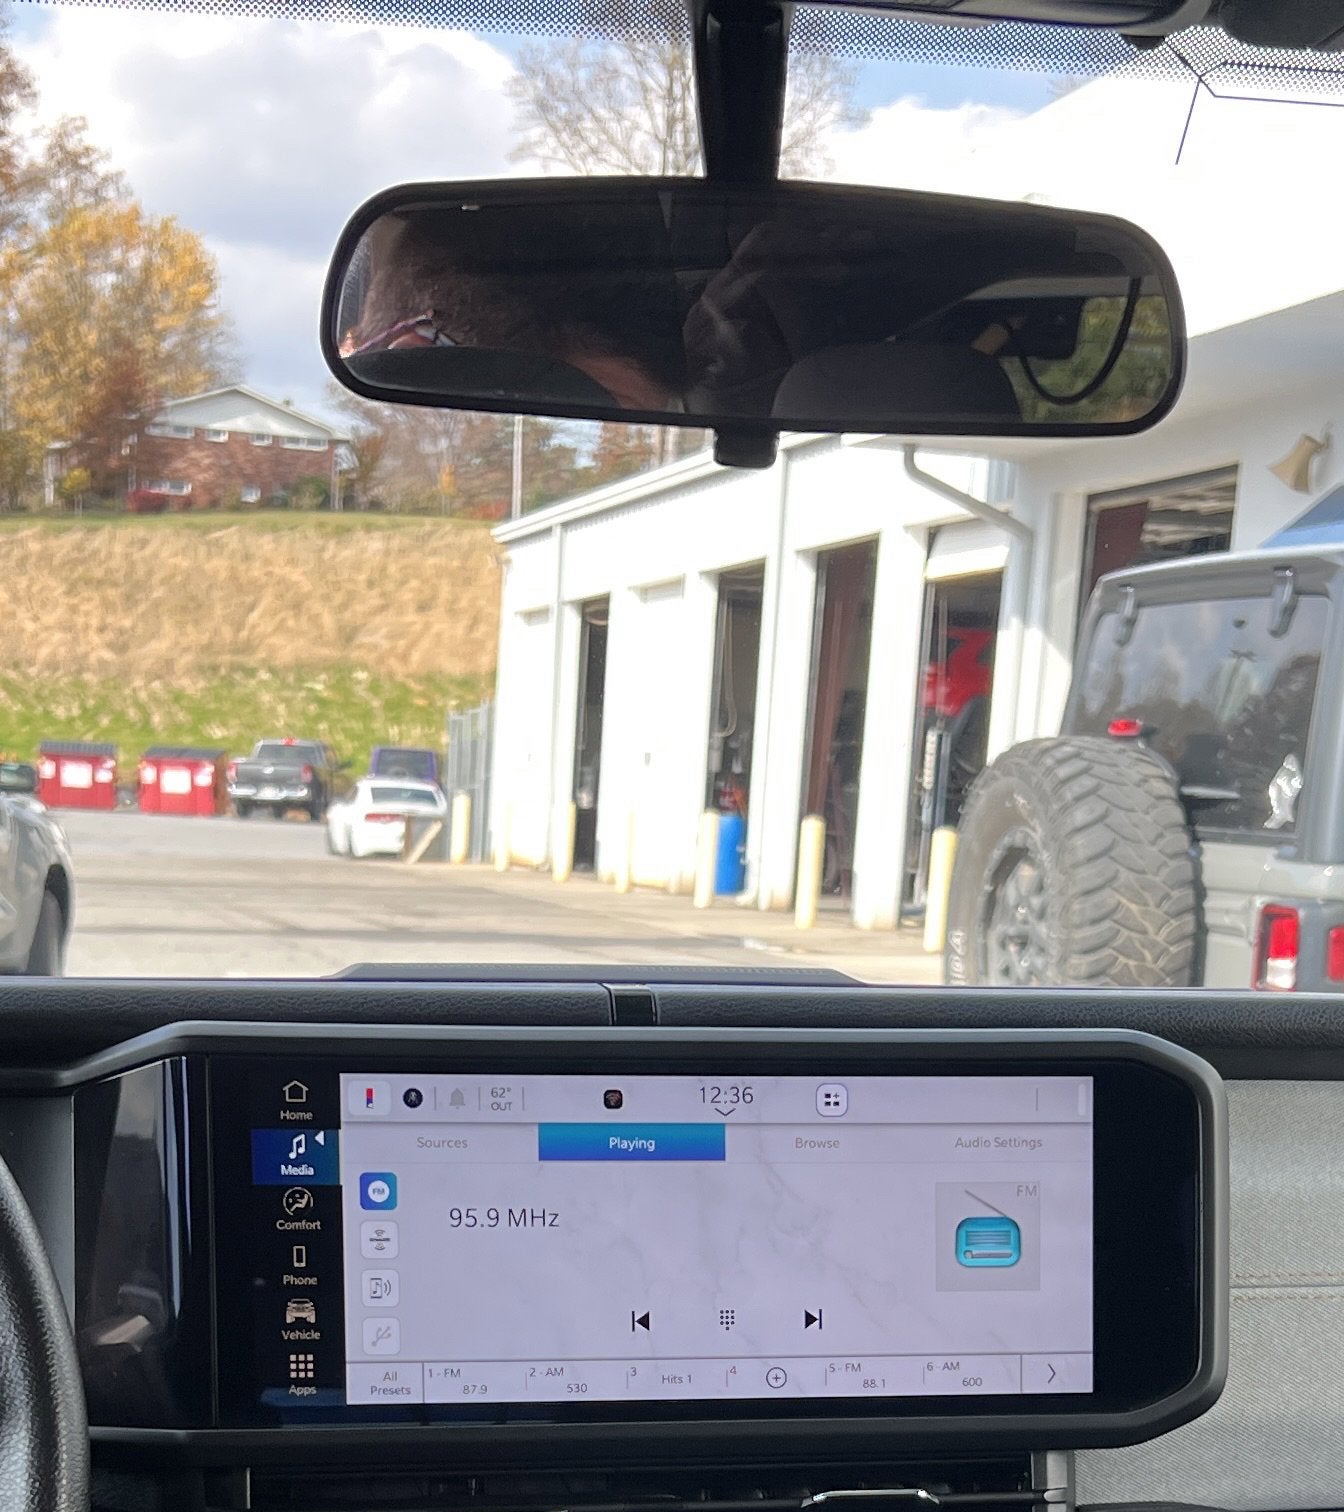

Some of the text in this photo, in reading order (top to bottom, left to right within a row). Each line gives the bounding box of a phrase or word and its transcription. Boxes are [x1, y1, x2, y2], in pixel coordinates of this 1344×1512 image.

[699, 1086, 754, 1105] 12:36
[490, 1101, 513, 1112] OUT
[279, 1109, 313, 1121] Home
[416, 1136, 468, 1149] Sources
[609, 1136, 656, 1151] Playing
[795, 1137, 840, 1149] Browse
[955, 1136, 1043, 1151] Audio Settings
[280, 1164, 314, 1176] Media
[1016, 1184, 1038, 1197] FM
[449, 1207, 560, 1228] 95.9 MHz
[276, 1219, 321, 1231] Comfort
[282, 1274, 318, 1286] Phone
[281, 1329, 321, 1341] Vehicle
[443, 1367, 461, 1378] FM
[529, 1367, 536, 1378] 2
[545, 1366, 566, 1377] AM
[630, 1366, 638, 1377] 3
[729, 1365, 737, 1376] 4
[829, 1363, 836, 1374] 5
[844, 1363, 861, 1374] FM
[926, 1361, 934, 1372] 6
[941, 1361, 961, 1372] AM
[382, 1371, 398, 1383] All
[661, 1373, 683, 1384] Hits
[962, 1376, 984, 1387] 600
[462, 1384, 488, 1395] 87.9
[566, 1383, 588, 1394] 530
[862, 1378, 887, 1389] 88.1
[288, 1384, 317, 1397] Apps
[370, 1384, 412, 1396] Presets
